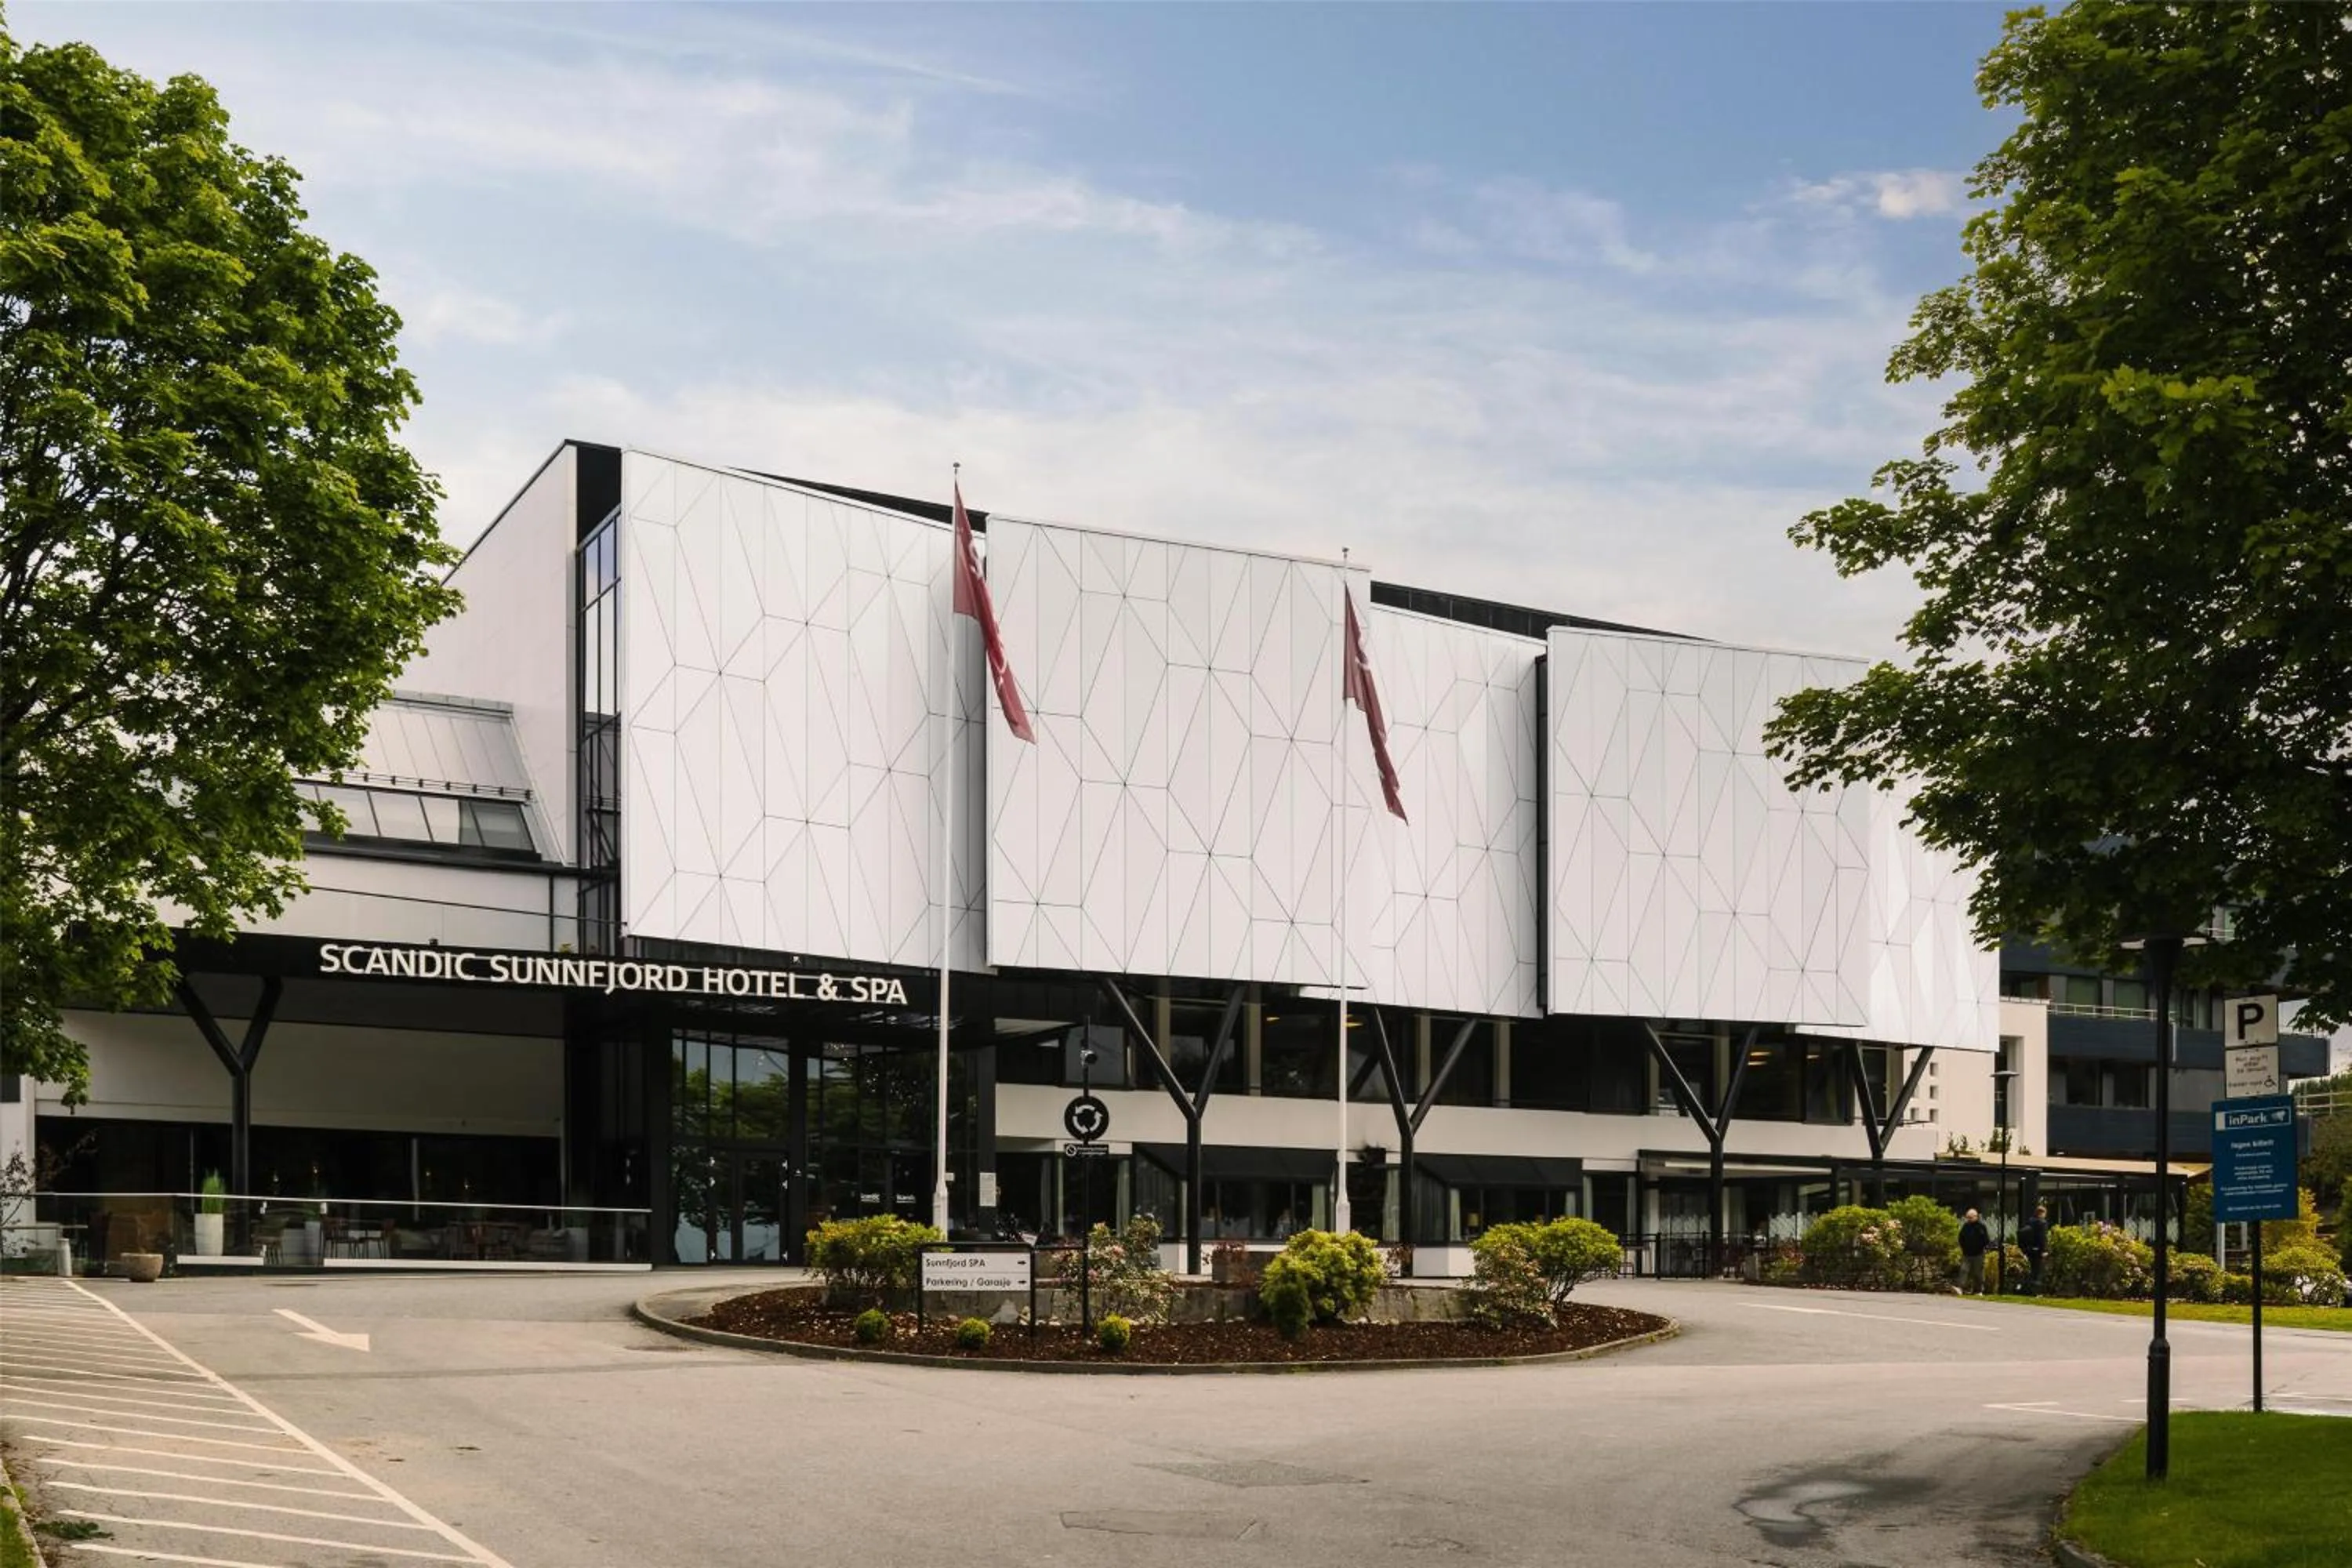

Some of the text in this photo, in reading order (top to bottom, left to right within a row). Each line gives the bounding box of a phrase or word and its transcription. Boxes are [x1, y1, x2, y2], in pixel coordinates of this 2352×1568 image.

[320, 944, 908, 1005] SCANDIC SUNNFJORD HOTEL & SPA
[2238, 1003, 2265, 1040] P
[2229, 1112, 2268, 1126] inPark
[926, 1258, 967, 1269] Sunnfjord
[926, 1277, 967, 1287] Parkering
[977, 1277, 1011, 1287] Garasje
